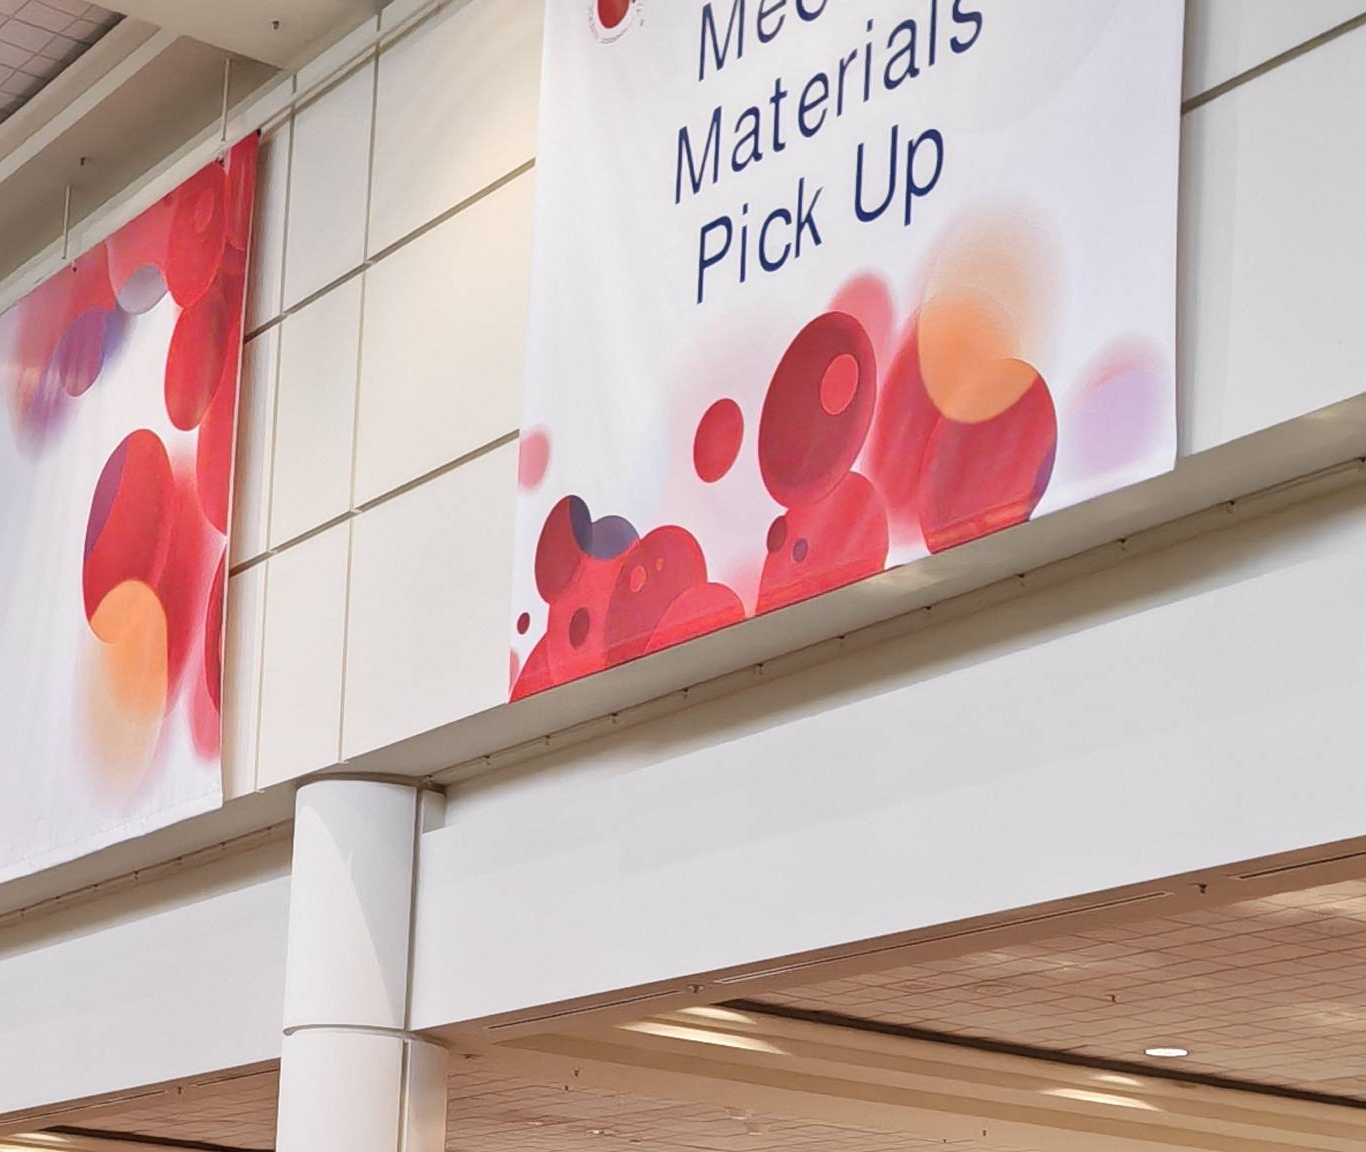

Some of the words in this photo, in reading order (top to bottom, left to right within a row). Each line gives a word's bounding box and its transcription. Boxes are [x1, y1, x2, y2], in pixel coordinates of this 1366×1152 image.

[675, 0, 983, 205] Materials
[697, 177, 824, 304] Pick
[854, 124, 944, 227] Up
